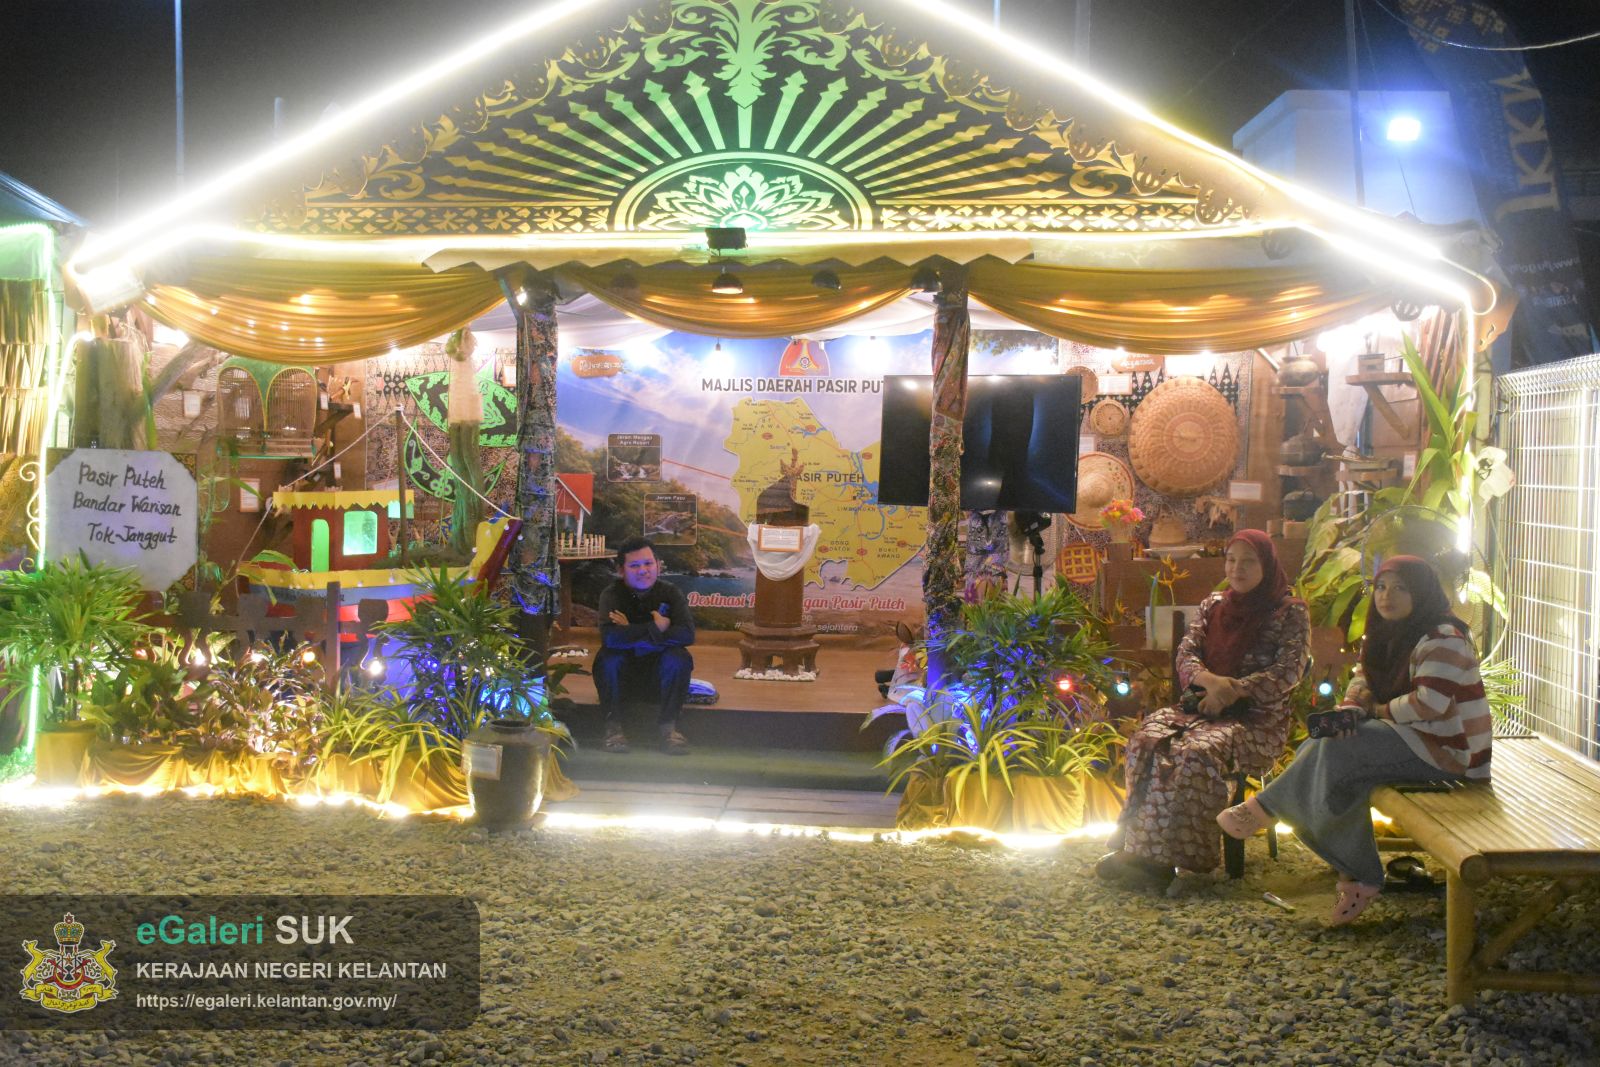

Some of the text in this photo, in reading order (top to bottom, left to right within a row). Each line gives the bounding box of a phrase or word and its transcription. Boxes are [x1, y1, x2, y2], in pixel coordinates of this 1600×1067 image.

[701, 377, 753, 393] MAJLIS
[757, 378, 812, 393] DAERAH
[816, 379, 857, 393] PASIR
[78, 461, 166, 490] Pasir Puteh
[797, 472, 864, 483] ASIR PUTEH
[72, 490, 182, 516] Bandar Warisan
[688, 592, 746, 608] Destinasi
[831, 596, 865, 610] Pasir
[869, 597, 905, 611] Puteh
